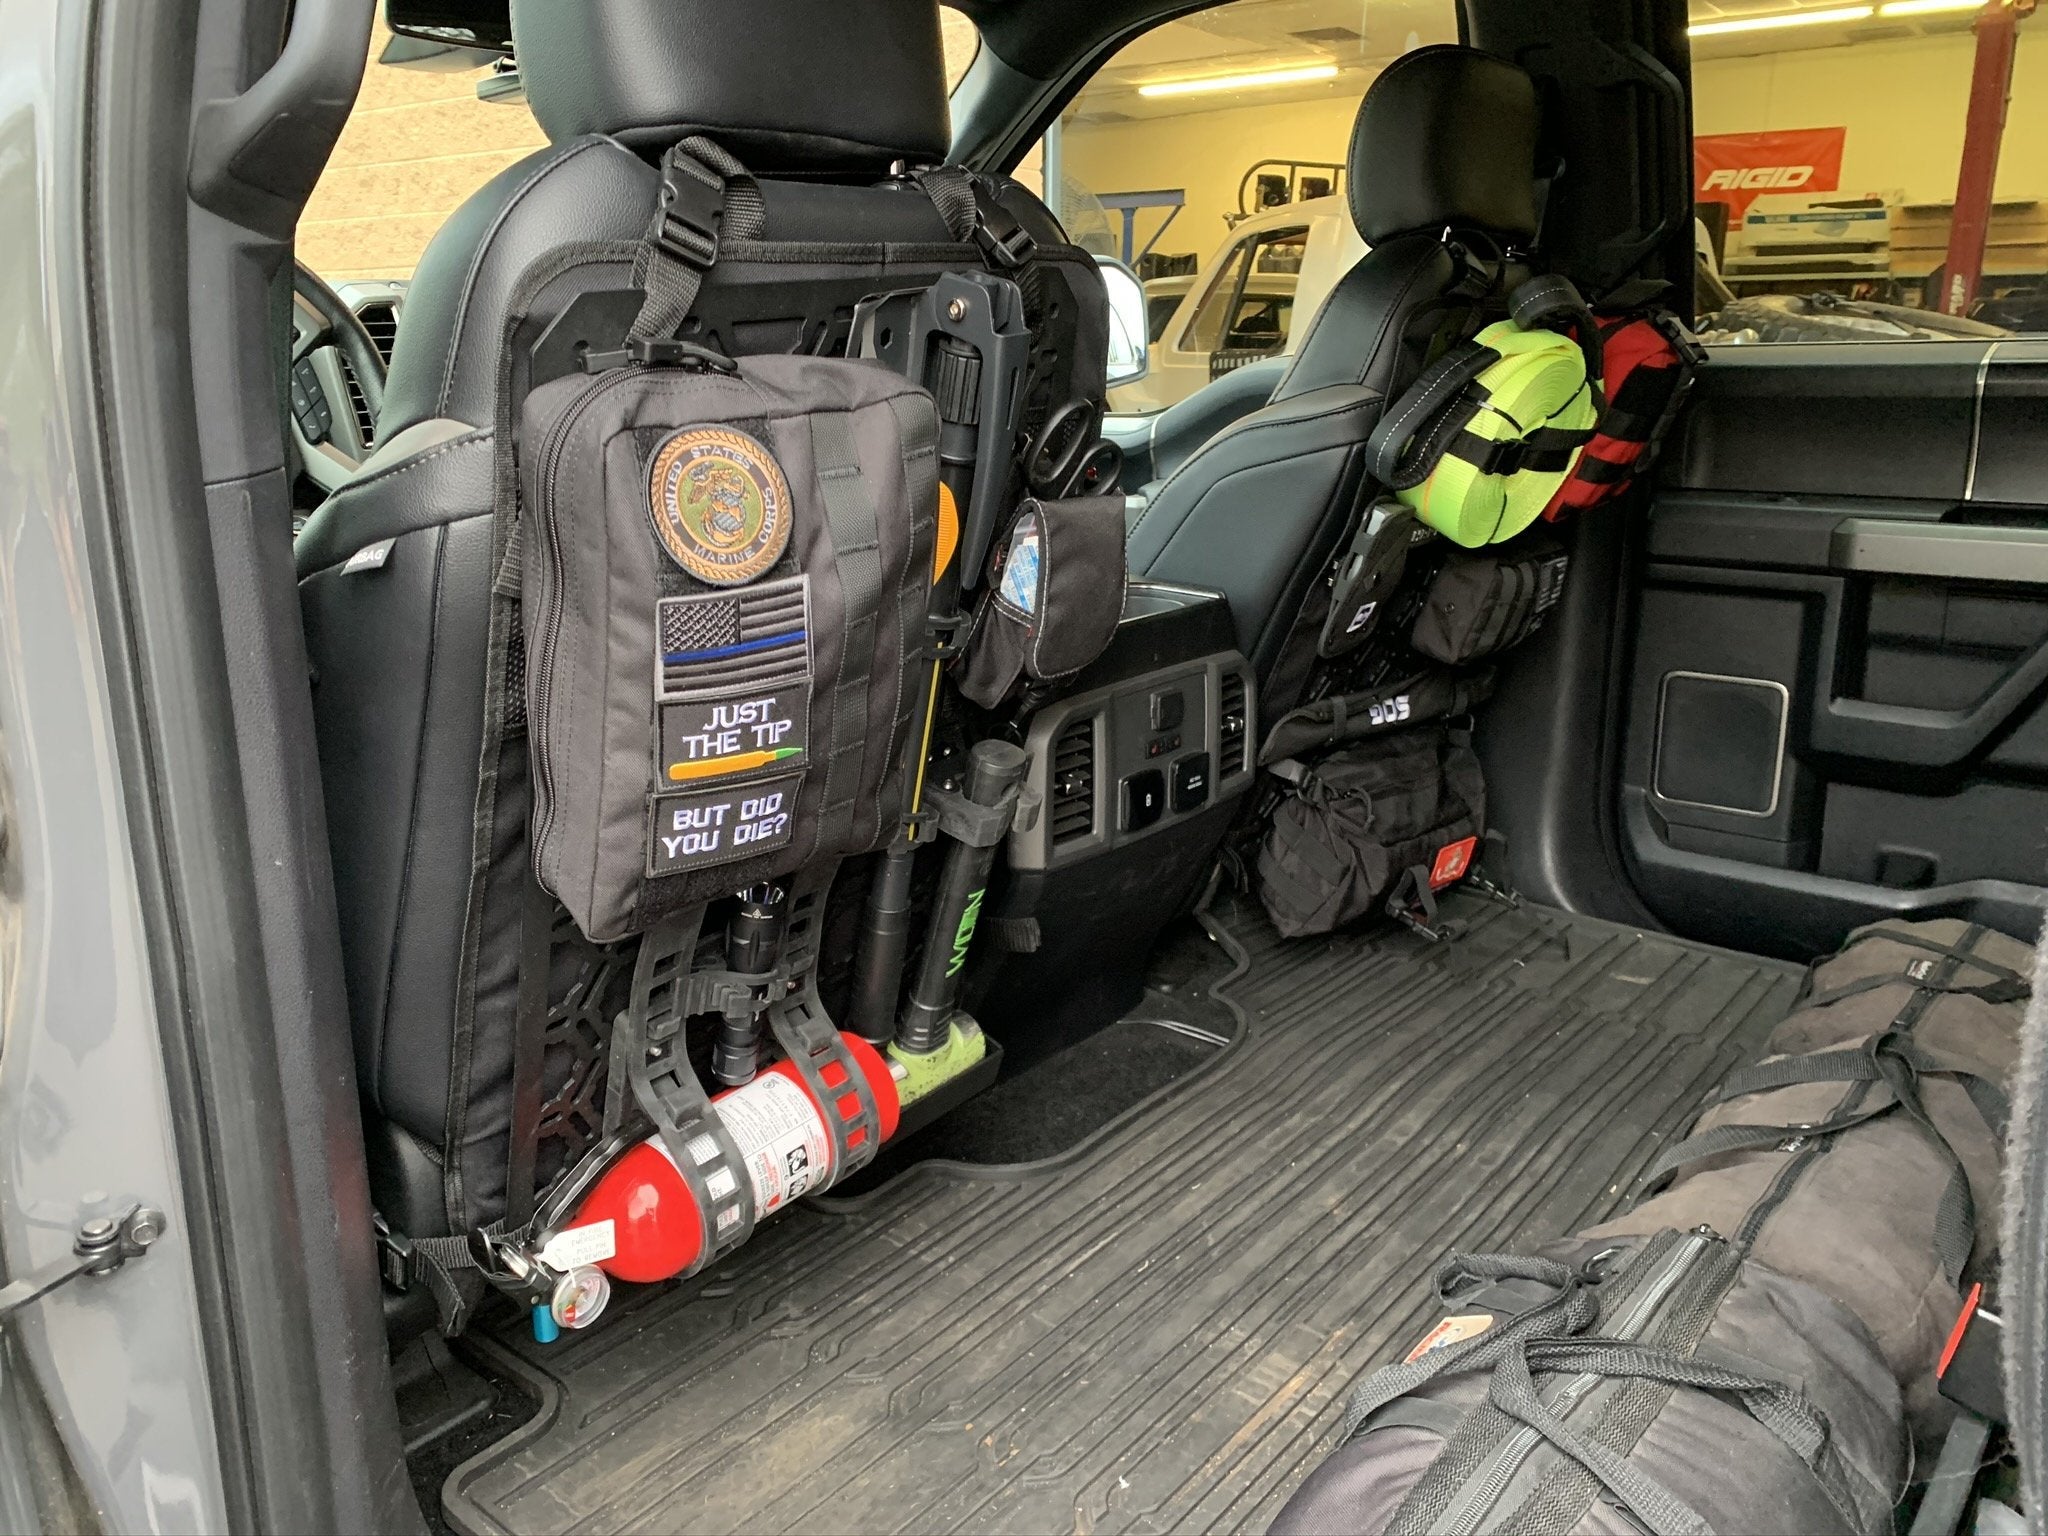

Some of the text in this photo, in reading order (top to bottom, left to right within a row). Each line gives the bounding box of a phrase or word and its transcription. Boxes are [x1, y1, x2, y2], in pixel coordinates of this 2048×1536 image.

[1701, 165, 1814, 192] RIGID
[665, 444, 754, 525] UNITED STATES
[694, 487, 777, 565] MARINE CORPS
[702, 697, 777, 731] JUST
[682, 719, 792, 759] THE TIP
[672, 792, 783, 831] BUT DID
[661, 812, 788, 859] YOU DIE?
